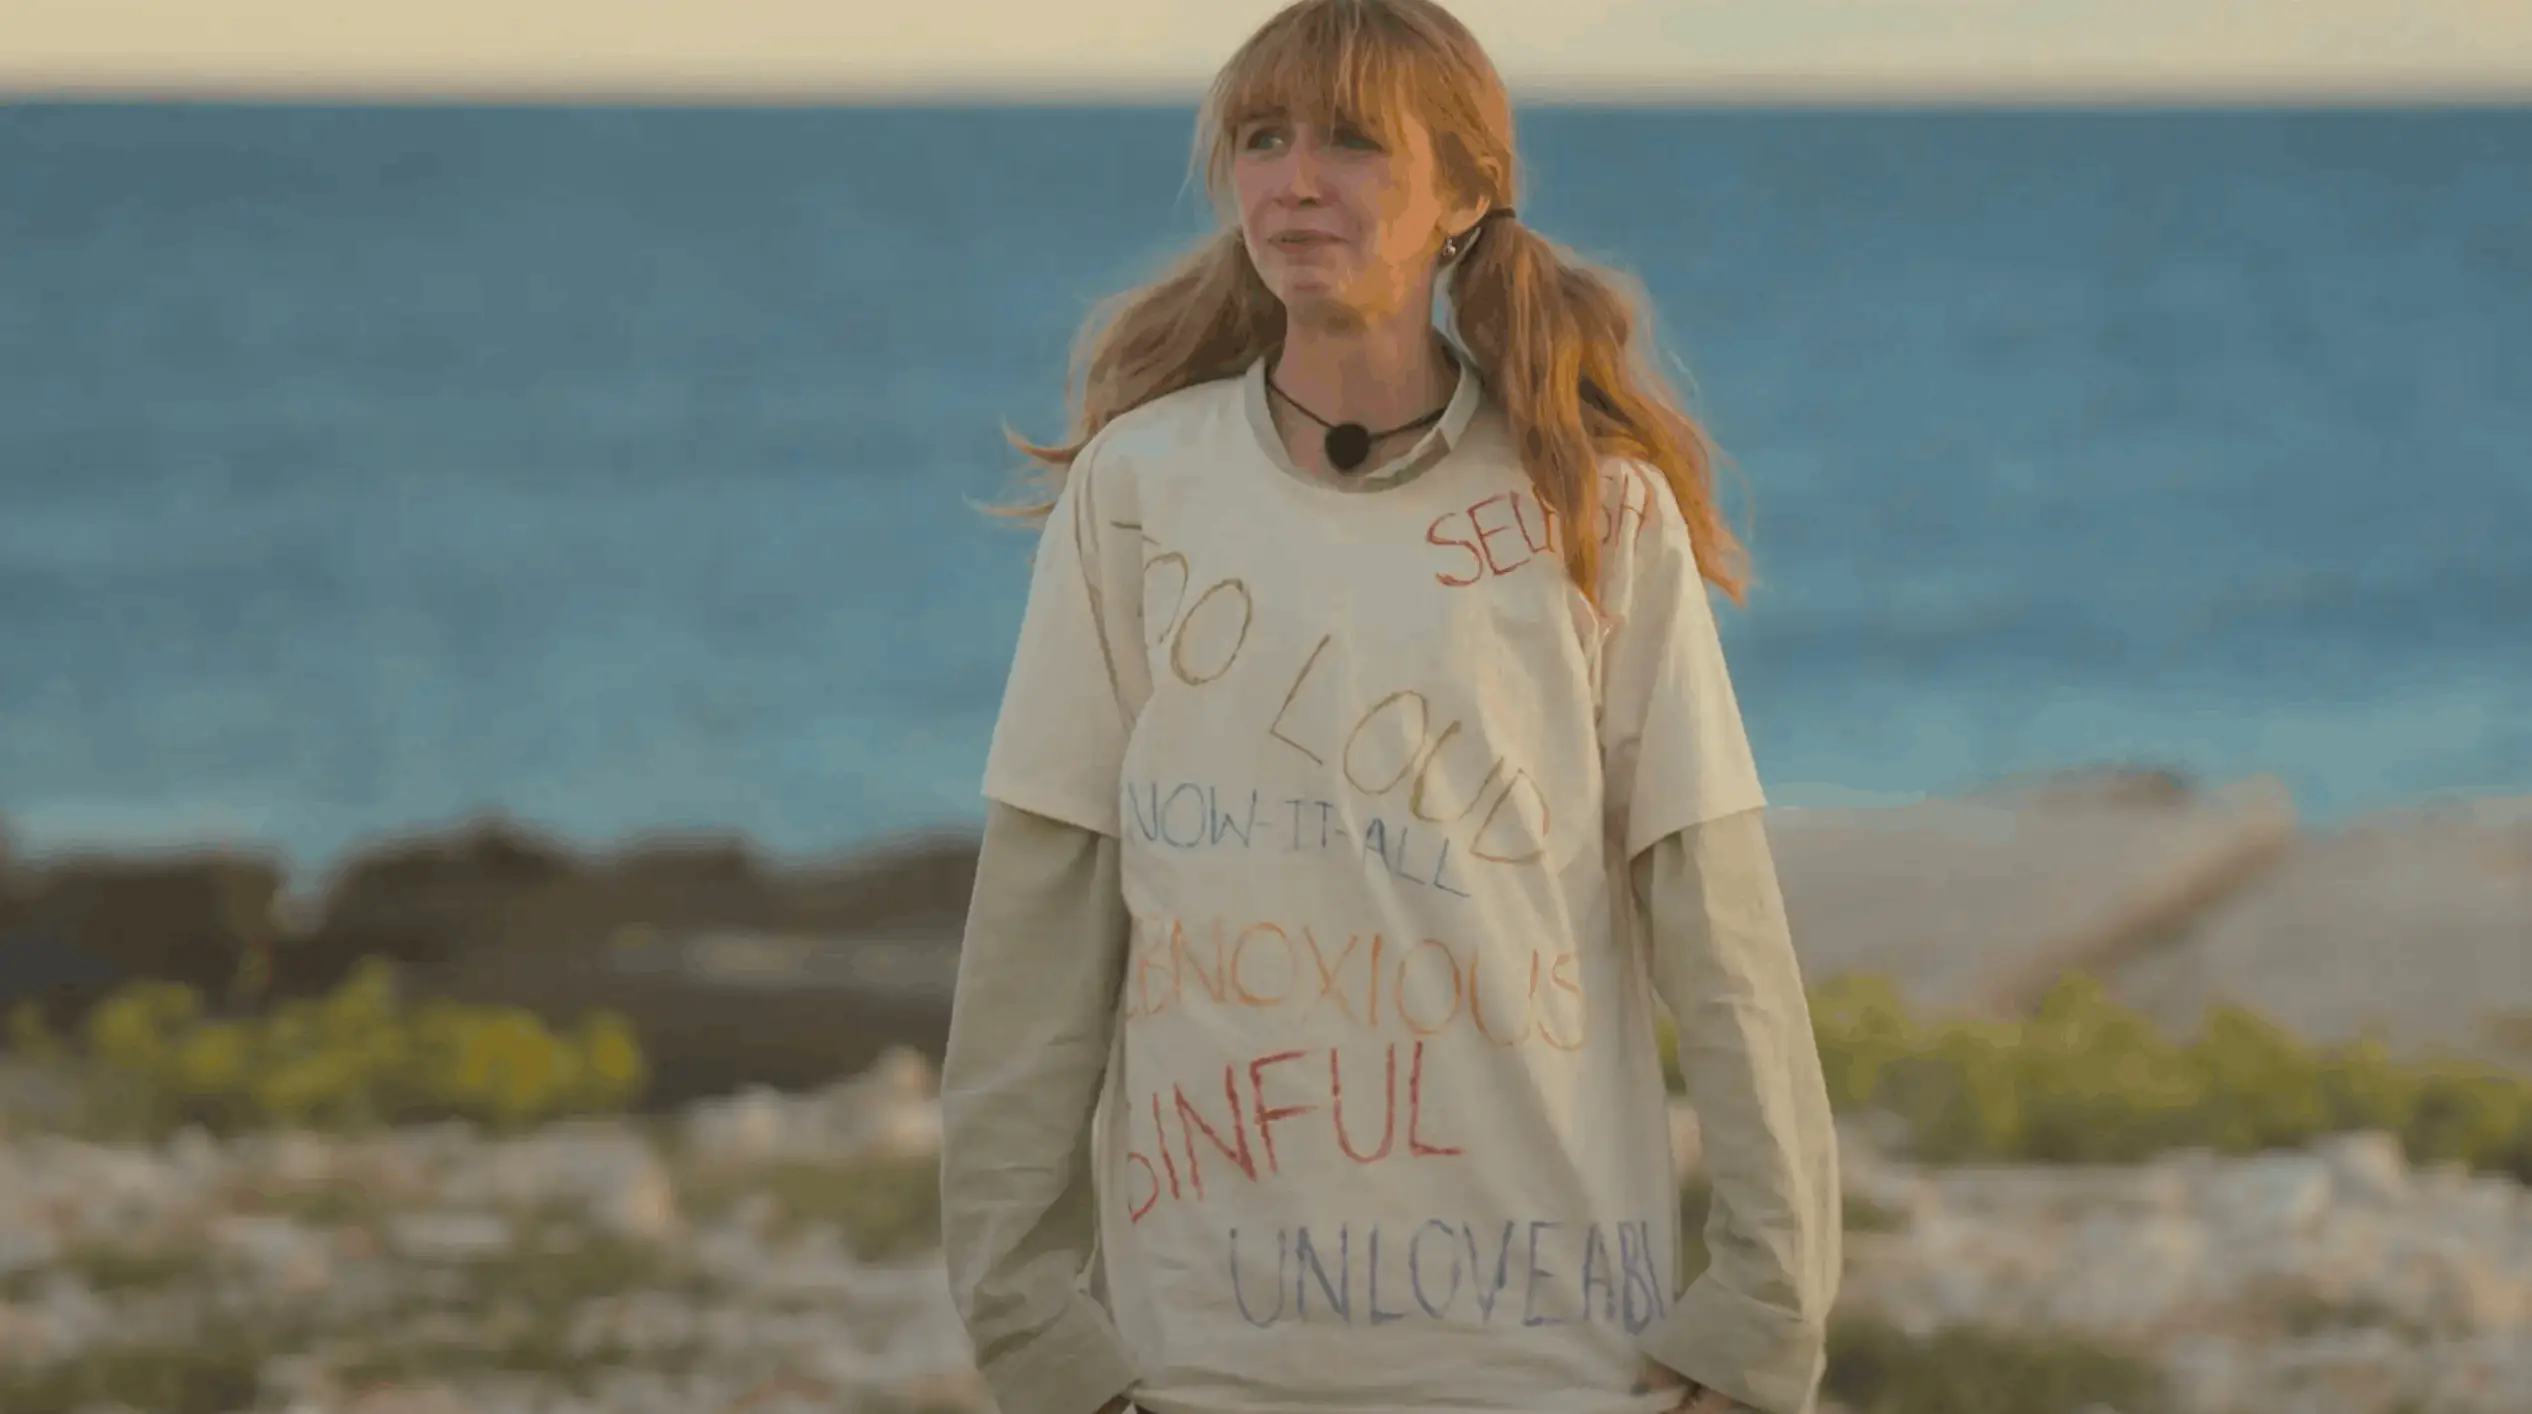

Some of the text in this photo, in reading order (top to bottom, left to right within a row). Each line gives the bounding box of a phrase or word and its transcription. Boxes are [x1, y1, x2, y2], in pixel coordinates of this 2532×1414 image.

[1270, 634, 1549, 864] LOUD
[1127, 782, 1471, 897] NOW-IT-ALL
[1127, 918, 1587, 1052] BNOXIOUS
[1230, 1218, 1667, 1336] UNLOVEABL
